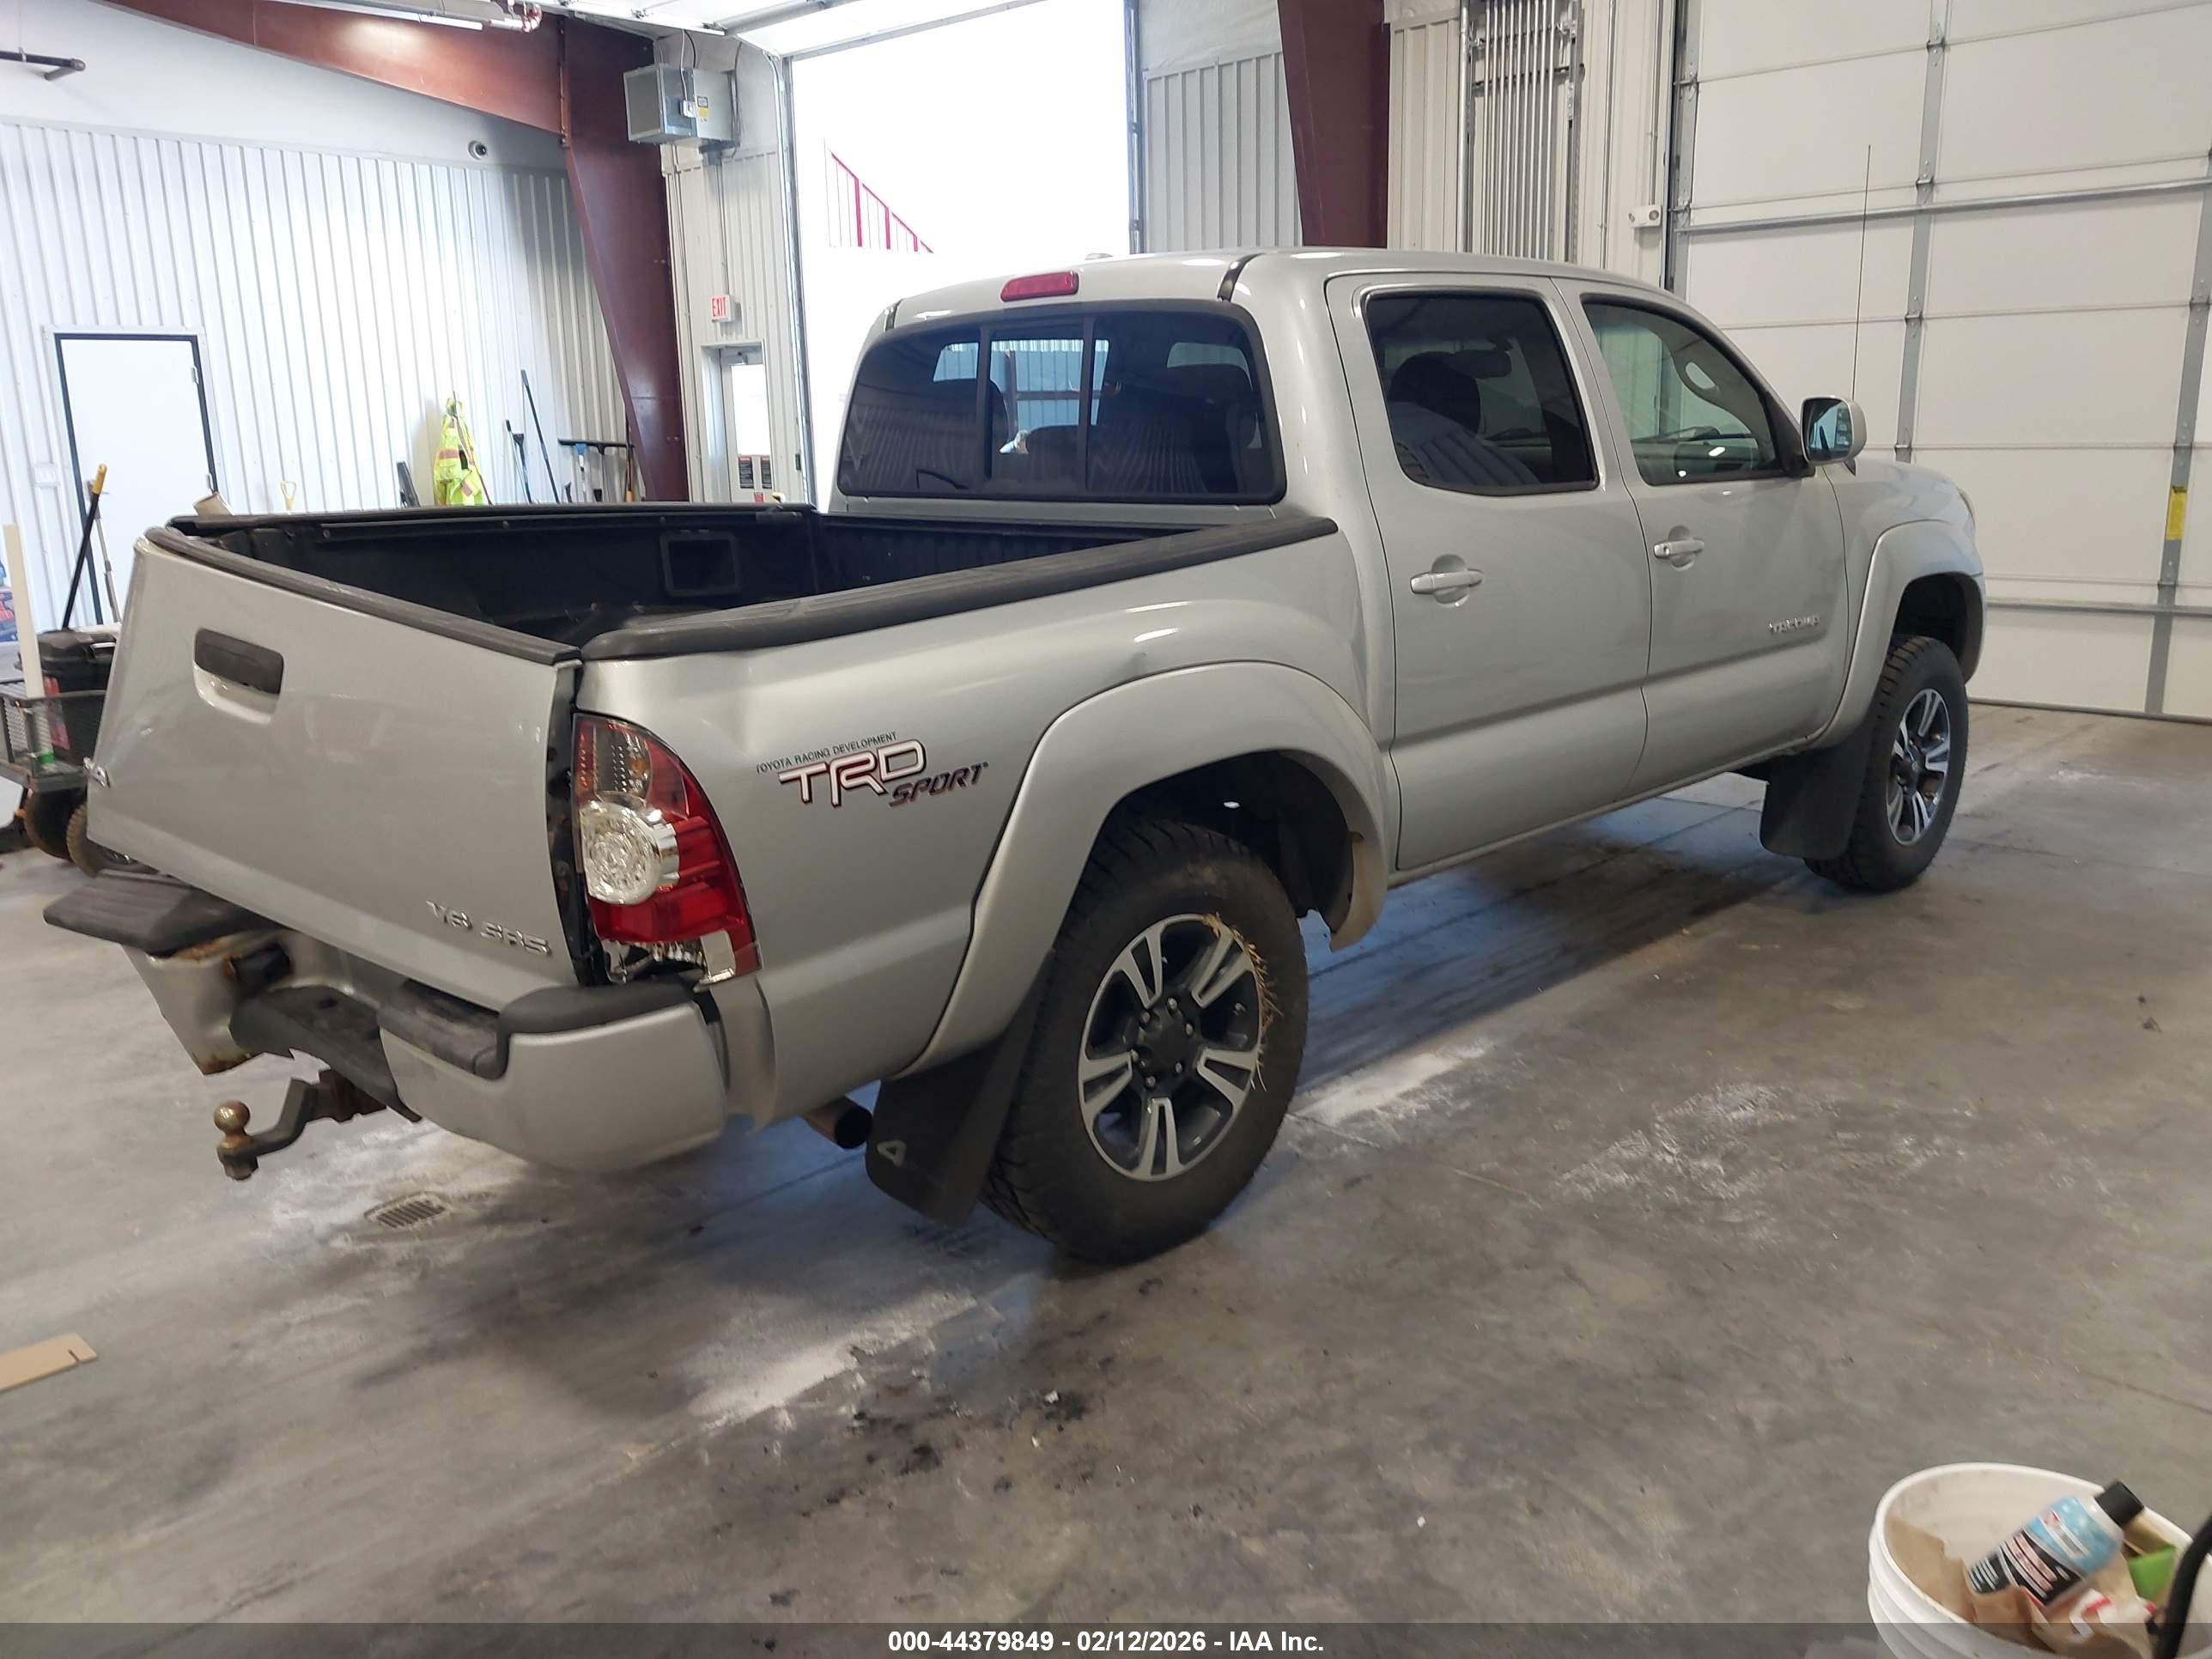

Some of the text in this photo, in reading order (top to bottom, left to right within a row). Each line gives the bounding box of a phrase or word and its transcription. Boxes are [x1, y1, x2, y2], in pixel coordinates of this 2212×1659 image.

[712, 296, 726, 317] EXIT
[756, 732, 898, 775] TOYOTA RACING DEVELOPMENT
[777, 738, 927, 809] TRD
[888, 763, 983, 808] SPORT
